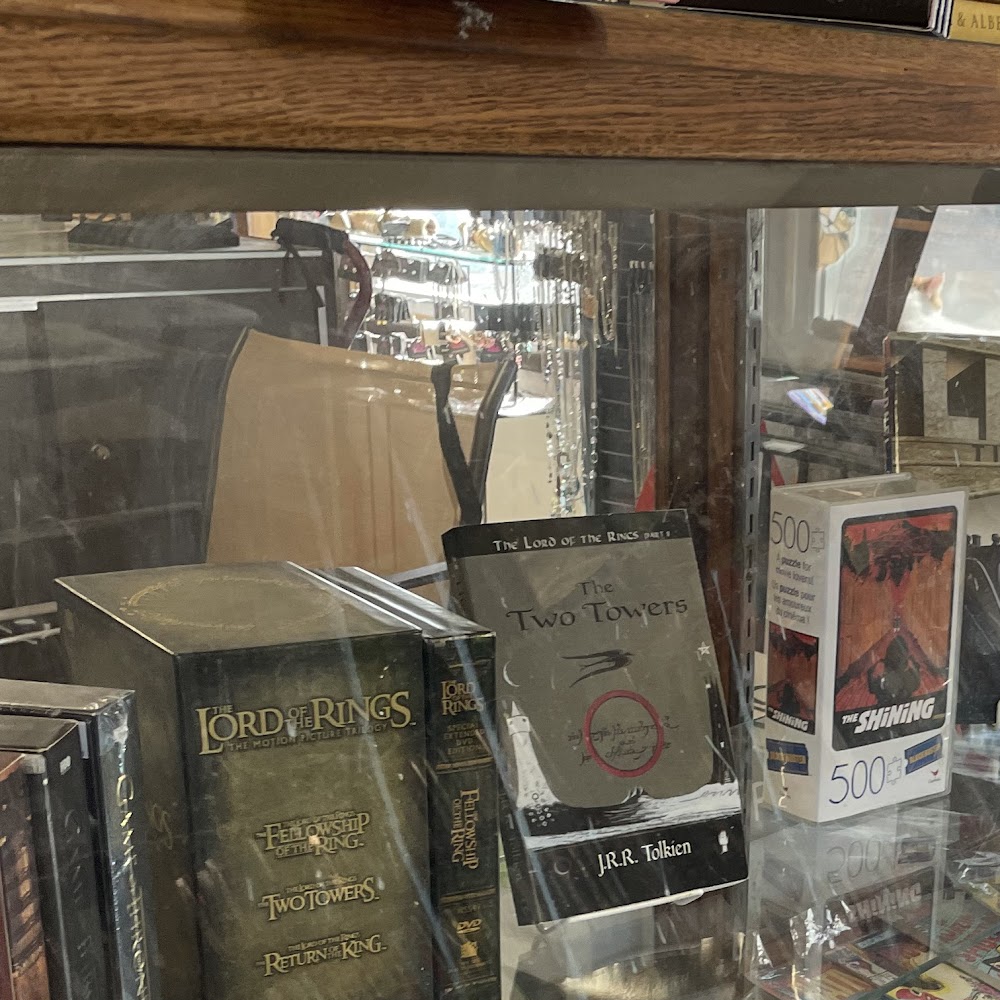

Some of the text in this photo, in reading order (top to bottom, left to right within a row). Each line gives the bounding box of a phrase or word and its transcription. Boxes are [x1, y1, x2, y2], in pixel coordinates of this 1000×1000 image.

[957, 15, 966, 27] &
[770, 511, 810, 553] 500
[781, 556, 801, 569] puzzle
[505, 579, 688, 631] The Two Towers
[779, 584, 800, 597] puzzle
[212, 704, 233, 715] THE
[288, 705, 307, 719] OF
[311, 690, 412, 731] RINGS
[442, 697, 484, 715] RINGS
[842, 712, 860, 725] THE
[195, 707, 284, 755] LORD
[228, 742, 250, 752] THE
[252, 736, 295, 749] MOTION
[300, 730, 342, 743] PICTURE
[828, 755, 886, 804] 500
[263, 812, 370, 850] FELLOWSHIP
[597, 840, 692, 877] J.R.R. Tolkien
[262, 893, 306, 921] TWO
[304, 877, 375, 911] TOWERS
[457, 919, 481, 933] DVD
[263, 949, 328, 977] RETURN
[341, 934, 381, 960] KING
